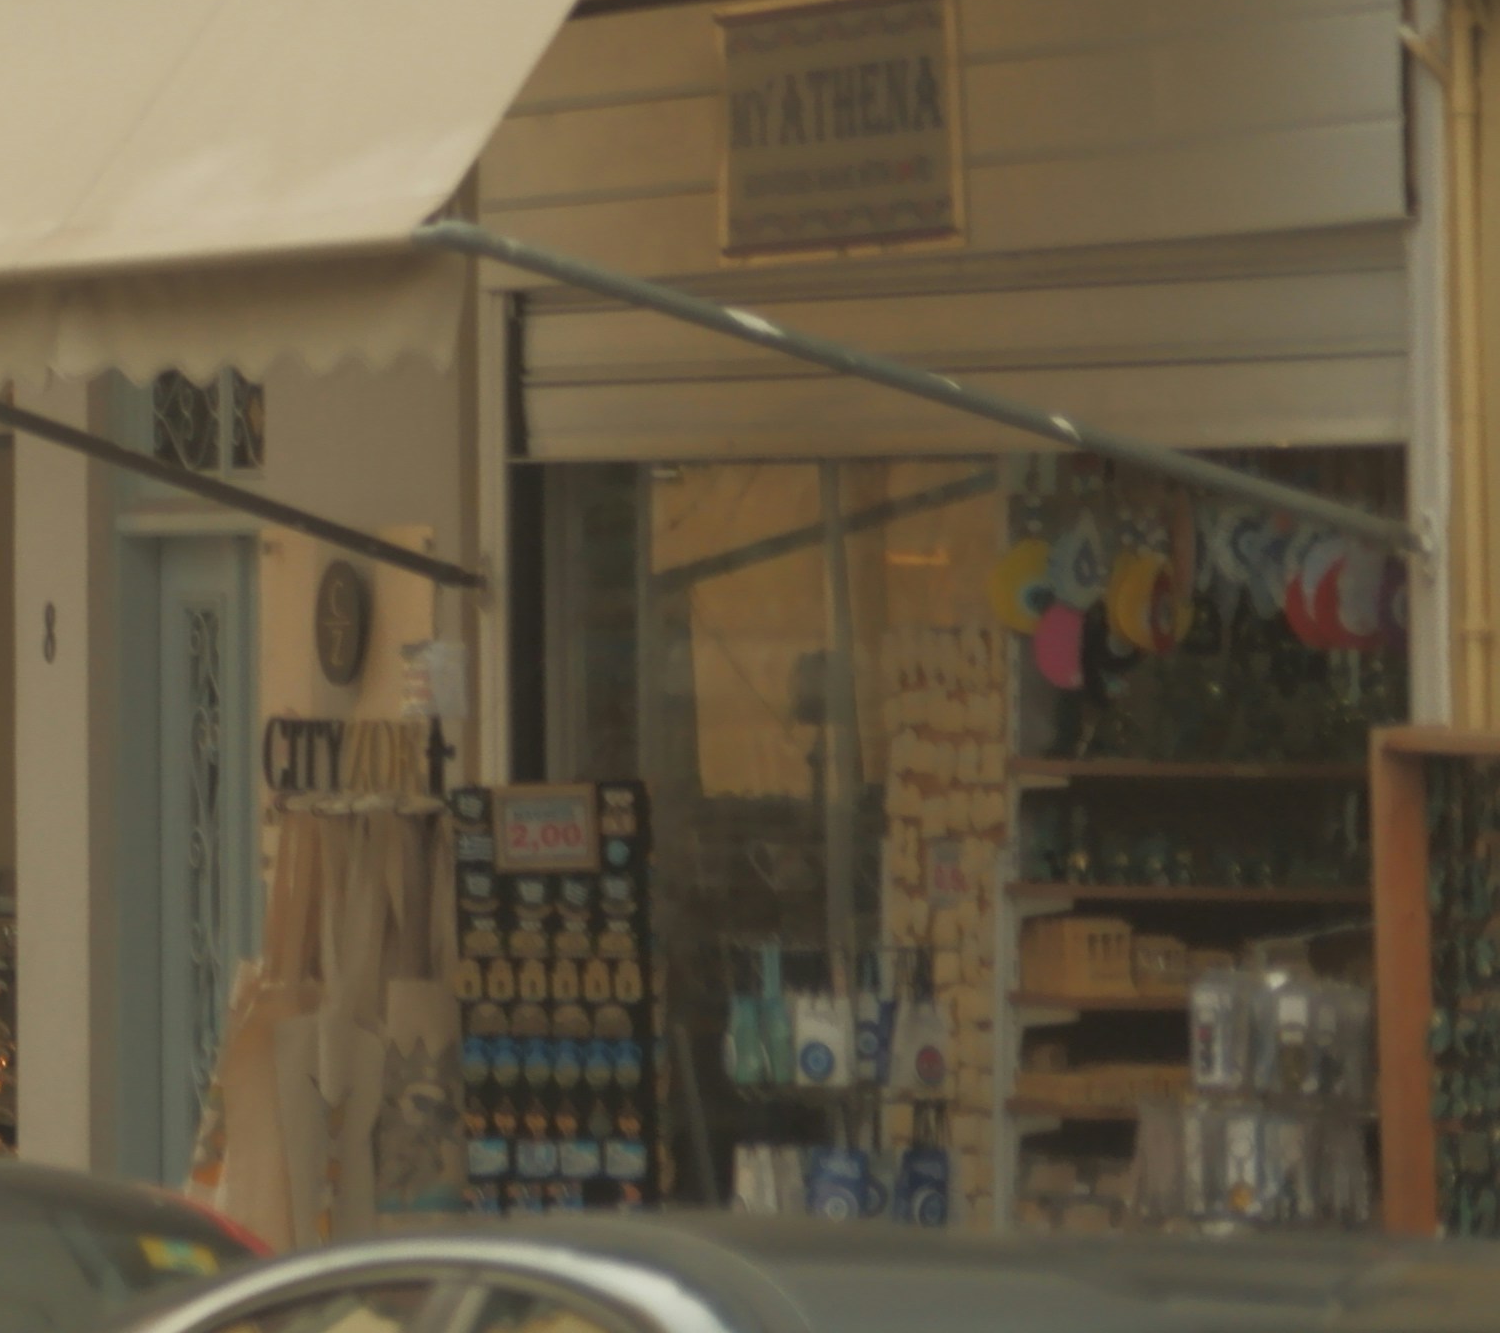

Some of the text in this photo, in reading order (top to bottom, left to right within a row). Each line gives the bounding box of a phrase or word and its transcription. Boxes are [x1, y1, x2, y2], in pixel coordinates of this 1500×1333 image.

[779, 55, 945, 146] ATHENA
[44, 600, 56, 664] 8
[509, 822, 583, 852] 2,00
